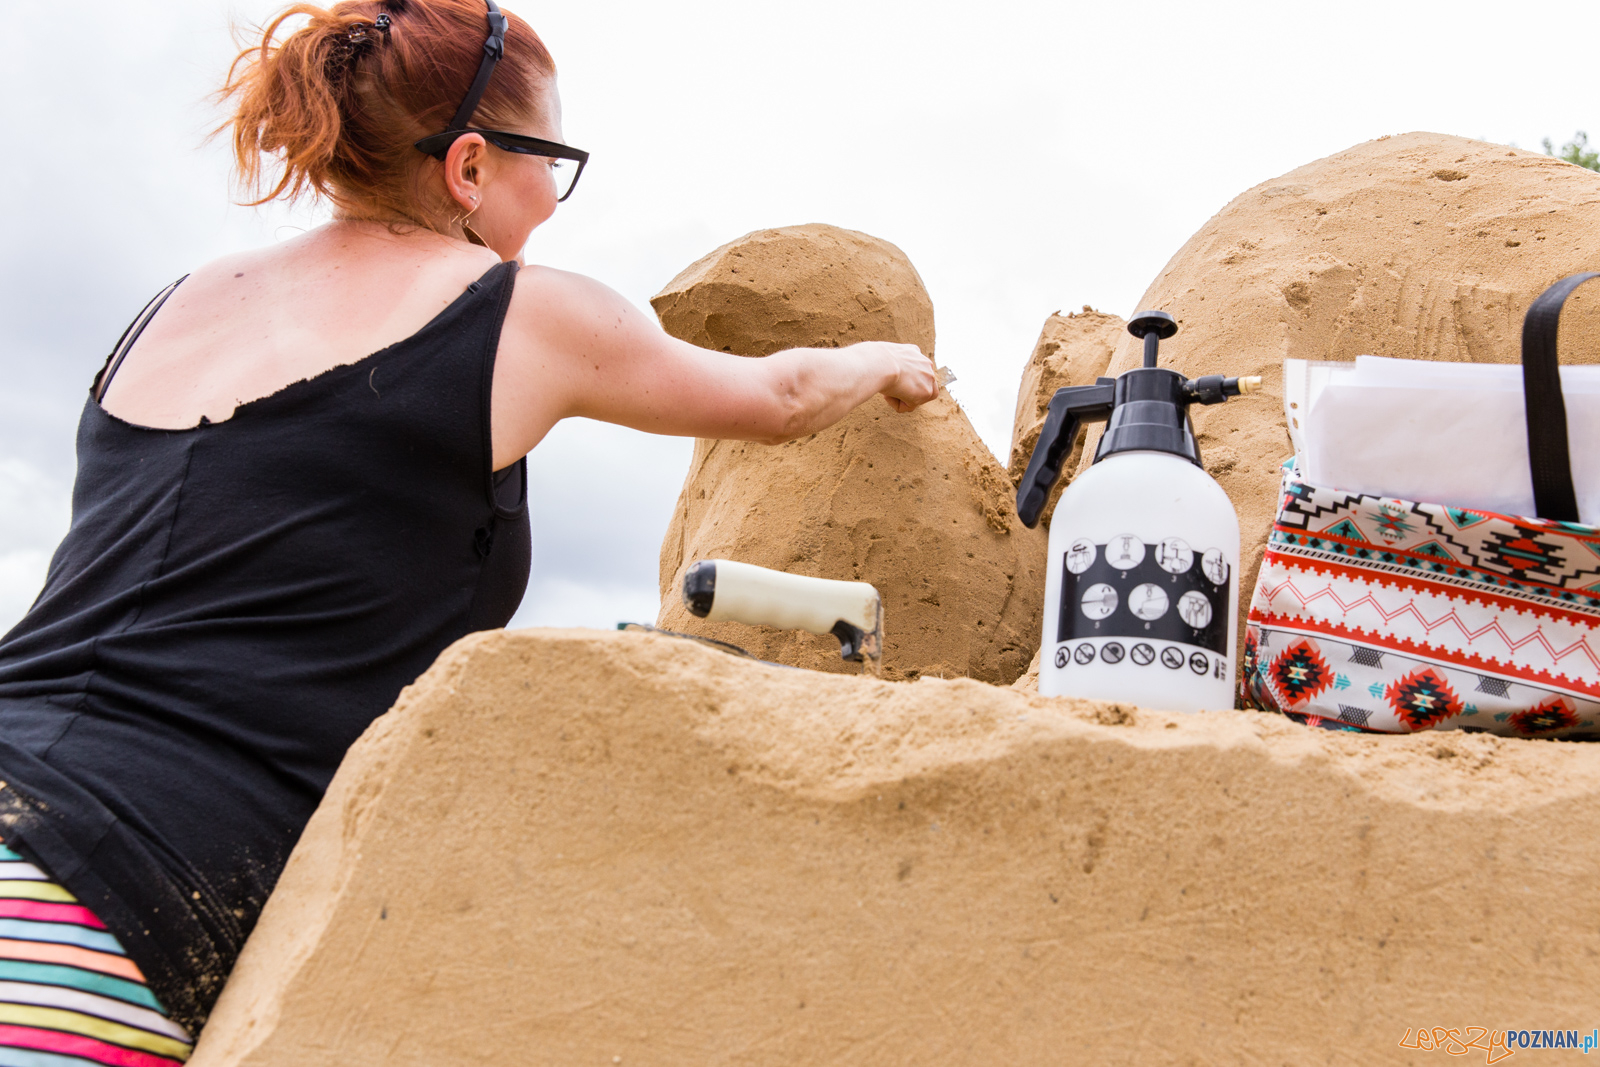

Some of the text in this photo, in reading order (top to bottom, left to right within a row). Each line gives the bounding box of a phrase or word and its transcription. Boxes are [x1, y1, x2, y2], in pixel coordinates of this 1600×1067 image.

[1120, 571, 1127, 579] 2
[1171, 575, 1177, 583] 3
[1094, 621, 1100, 629] 5
[1144, 622, 1150, 630] 6
